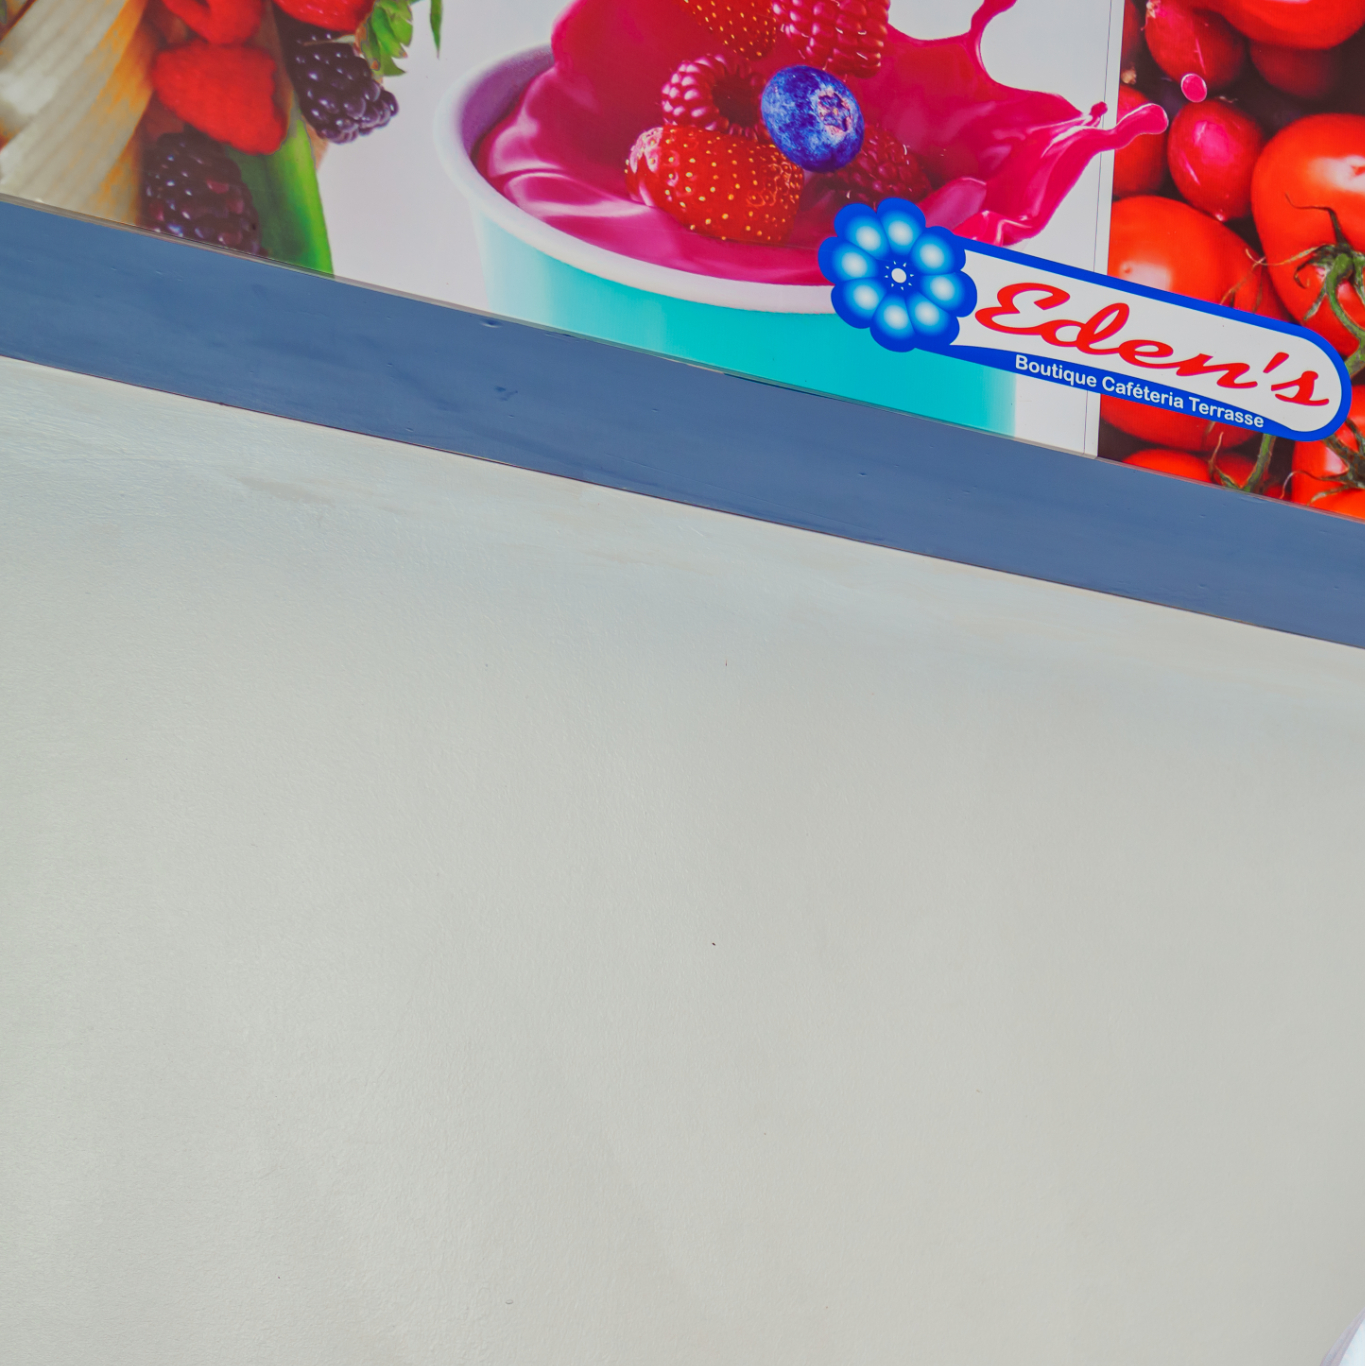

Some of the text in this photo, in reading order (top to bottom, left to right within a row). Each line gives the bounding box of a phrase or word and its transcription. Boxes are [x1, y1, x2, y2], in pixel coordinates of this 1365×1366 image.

[974, 281, 1330, 406] Eden's
[1015, 353, 1265, 428] Boutique Caféteria Terrasse
